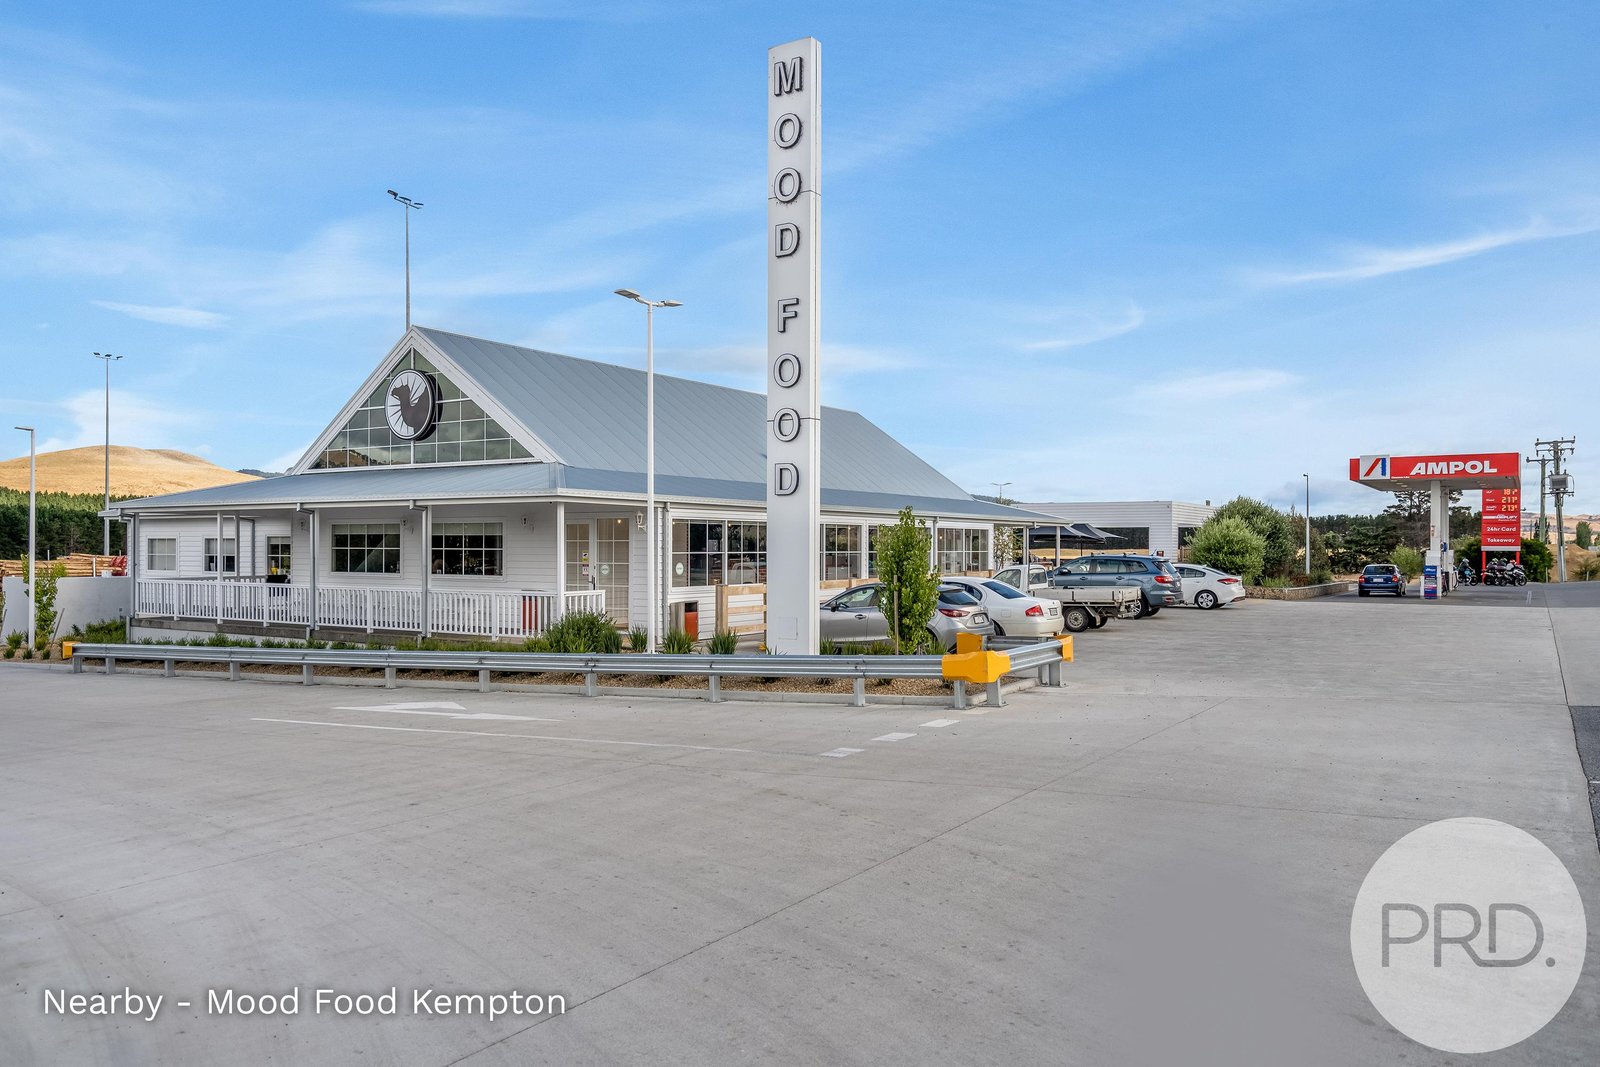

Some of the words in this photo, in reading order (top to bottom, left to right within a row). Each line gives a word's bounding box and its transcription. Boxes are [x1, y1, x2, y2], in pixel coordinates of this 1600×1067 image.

[773, 56, 803, 258] MOOD
[773, 297, 802, 496] FOOD
[1409, 460, 1498, 476] AMPOL
